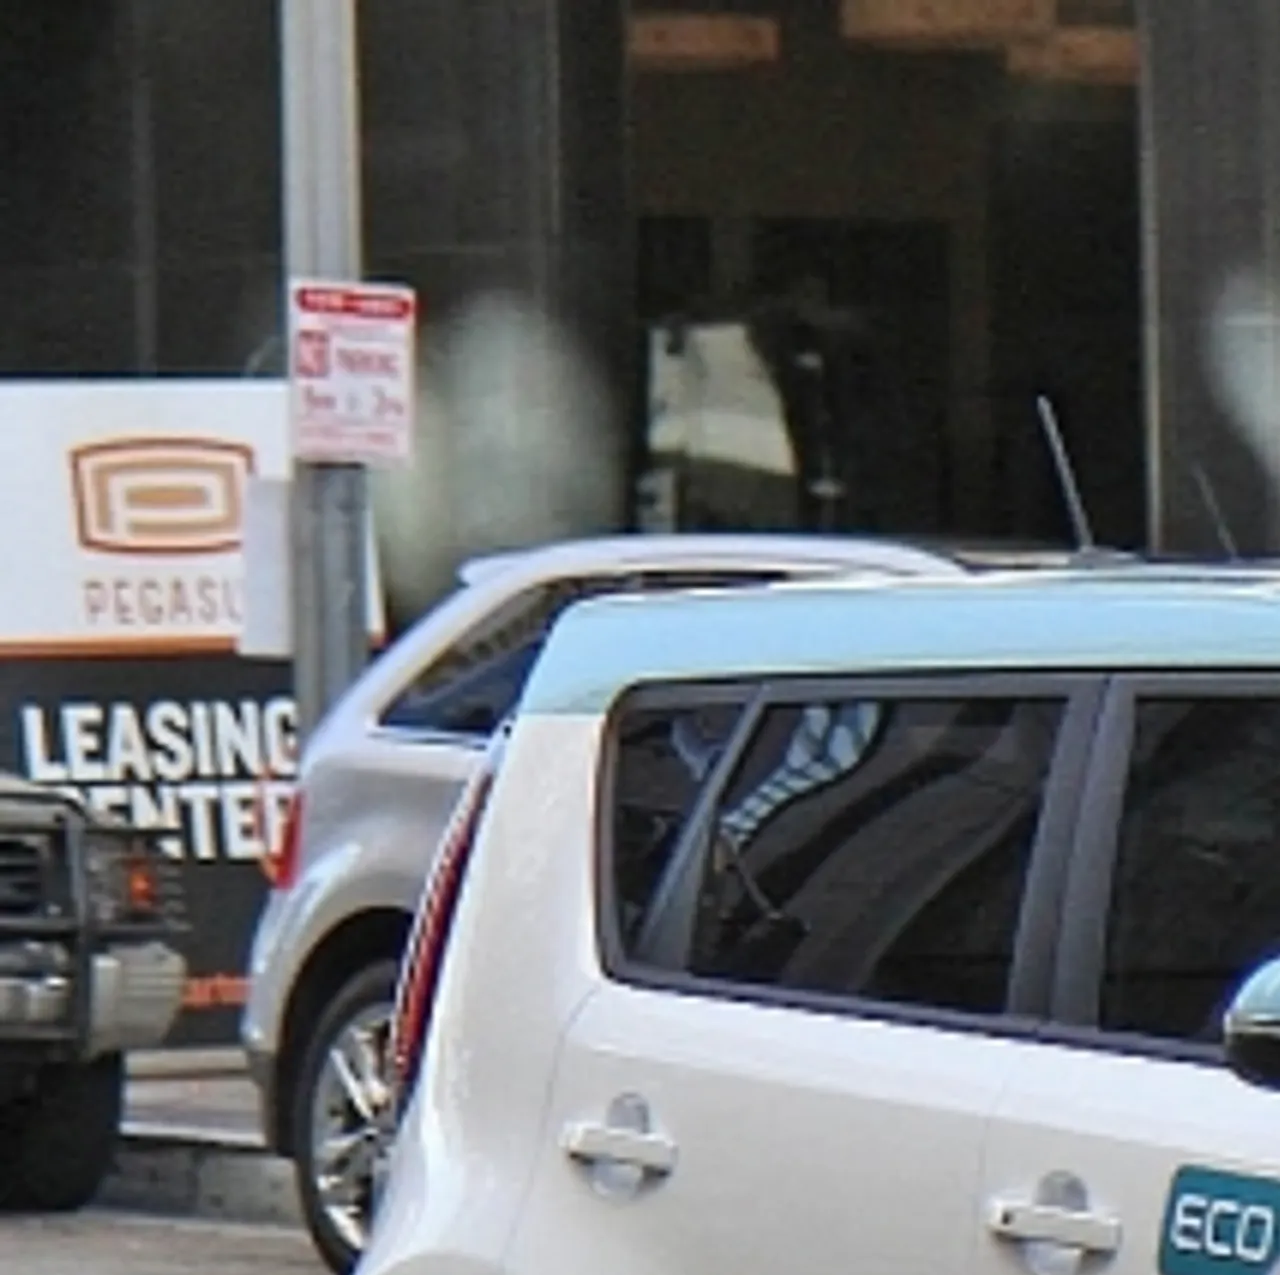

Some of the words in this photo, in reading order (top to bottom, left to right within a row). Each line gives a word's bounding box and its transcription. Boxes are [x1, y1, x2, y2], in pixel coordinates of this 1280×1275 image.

[82, 576, 243, 626] PEGASU
[21, 697, 297, 782] LEASING
[1170, 1194, 1274, 1262] ECO
